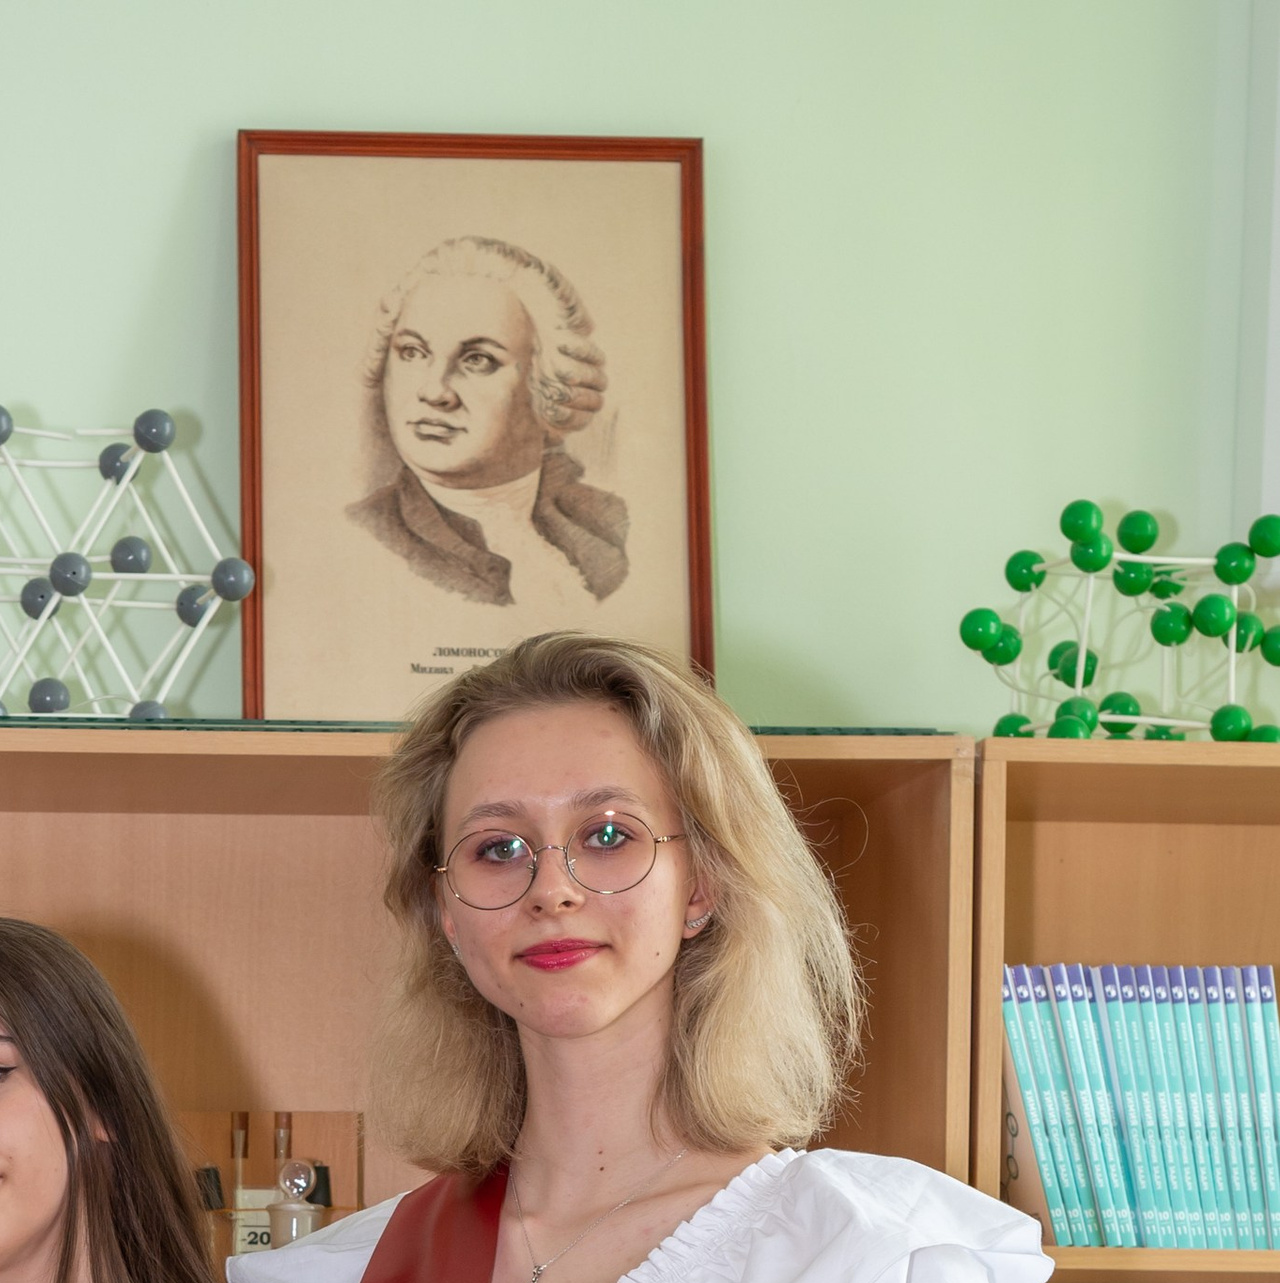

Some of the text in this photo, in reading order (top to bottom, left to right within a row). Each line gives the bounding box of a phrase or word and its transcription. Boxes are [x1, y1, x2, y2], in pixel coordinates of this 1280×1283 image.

[410, 662, 455, 675] Михаил
[1024, 1090, 1040, 1125] ХИМИЯ
[1043, 1090, 1058, 1125] ХИМИЯ
[1060, 1090, 1075, 1125] ХИМИЯ
[1080, 1090, 1095, 1125] ХИМИЯ
[1094, 1090, 1109, 1125] ХИМИЯ
[1125, 1091, 1139, 1126] ХИМИЯ
[1141, 1091, 1154, 1127] ХИМИЯ
[1158, 1091, 1171, 1127] ХИМИЯ
[1173, 1092, 1186, 1128] ХИМИЯ
[1189, 1092, 1202, 1128] ХИМИЯ
[1205, 1092, 1218, 1128] ХИМИЯ
[1223, 1092, 1235, 1128] ХИМИЯ
[1240, 1093, 1252, 1128] ХИМИЯ
[1259, 1092, 1271, 1128] ХИМИЯ
